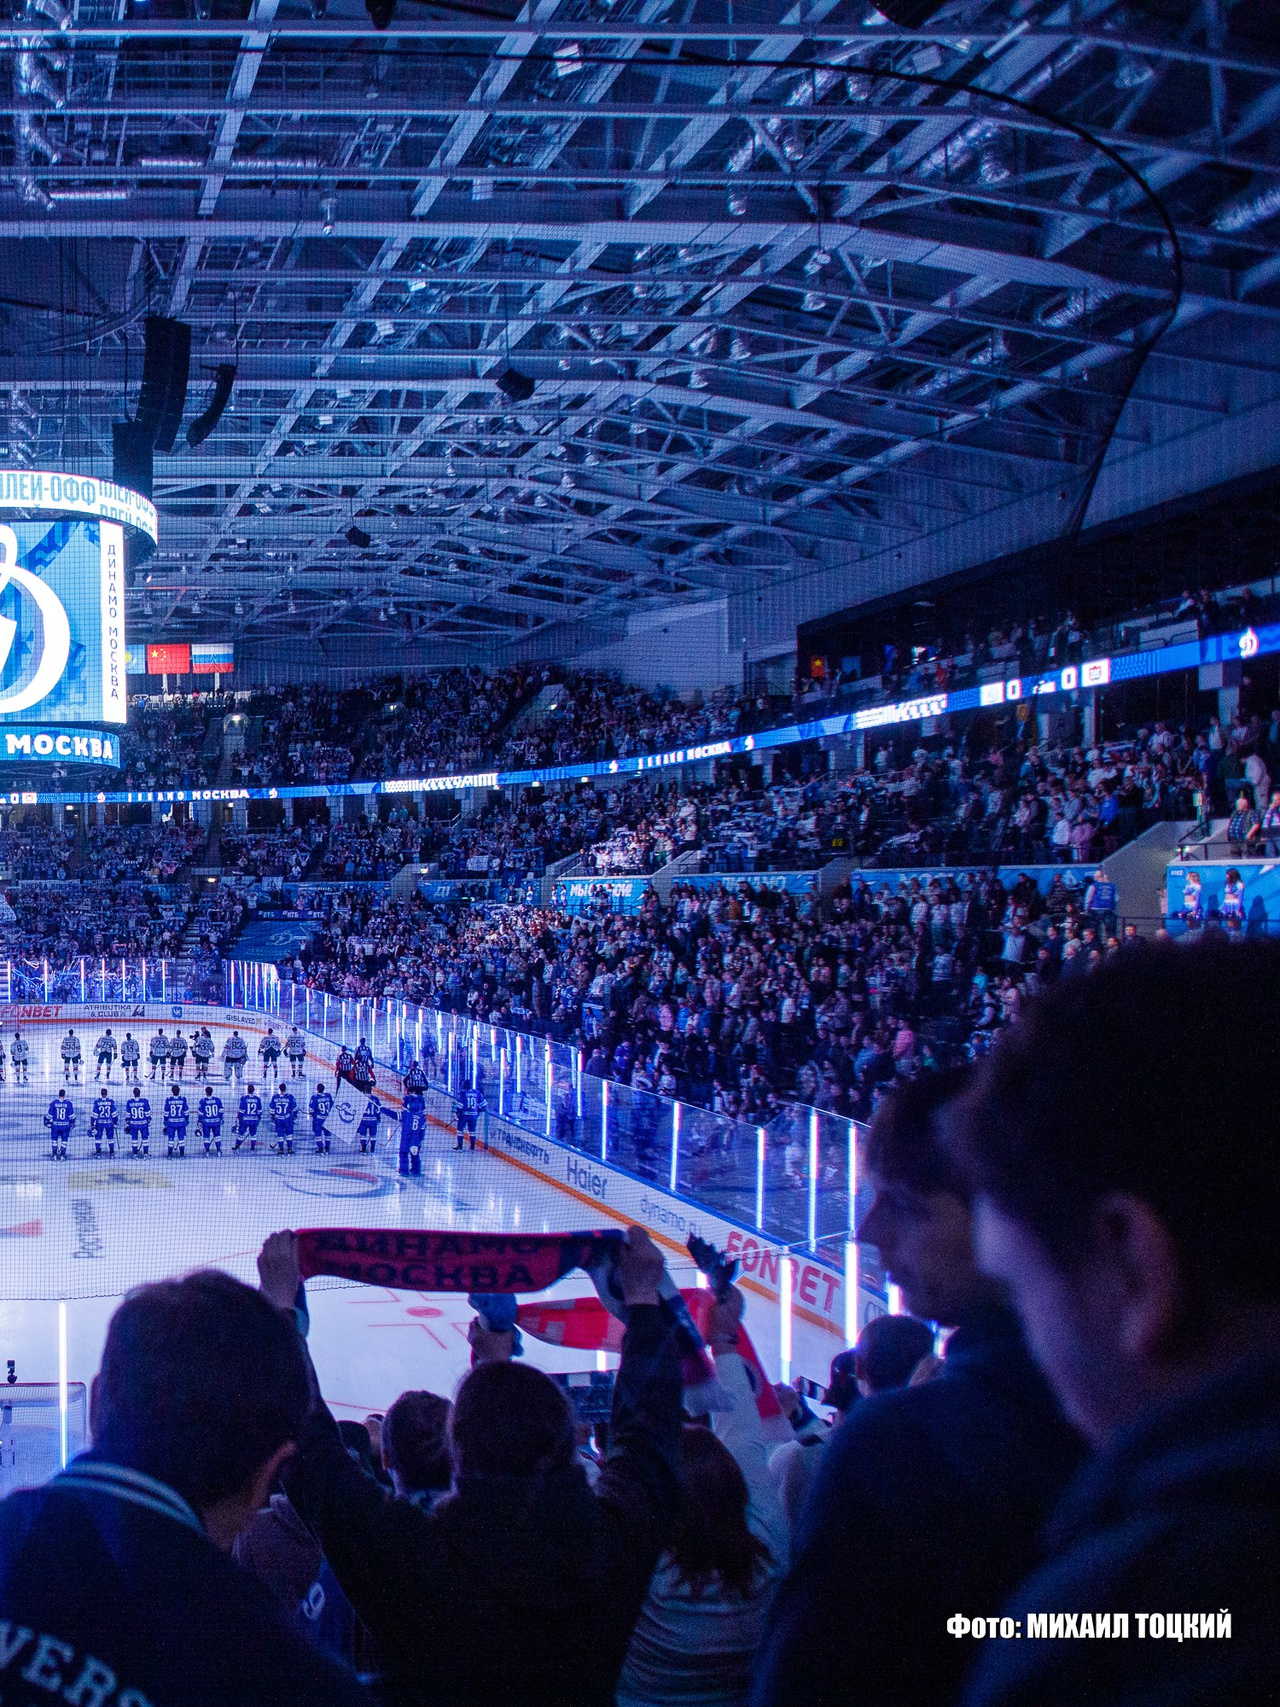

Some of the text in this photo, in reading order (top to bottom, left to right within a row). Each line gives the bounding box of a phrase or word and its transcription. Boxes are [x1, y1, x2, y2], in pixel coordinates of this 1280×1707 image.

[107, 545, 119, 700] ДИНАМО МОСКВА
[6, 733, 114, 760] МОСКВА
[0, 1005, 62, 1018] FONBET
[55, 1108, 66, 1119] 18
[98, 1106, 111, 1118] 23
[131, 1107, 144, 1119] 96
[170, 1105, 183, 1117] 87
[205, 1105, 218, 1117] 90
[246, 1103, 257, 1114] 12
[275, 1102, 288, 1114] 57
[566, 1156, 608, 1199] Haier
